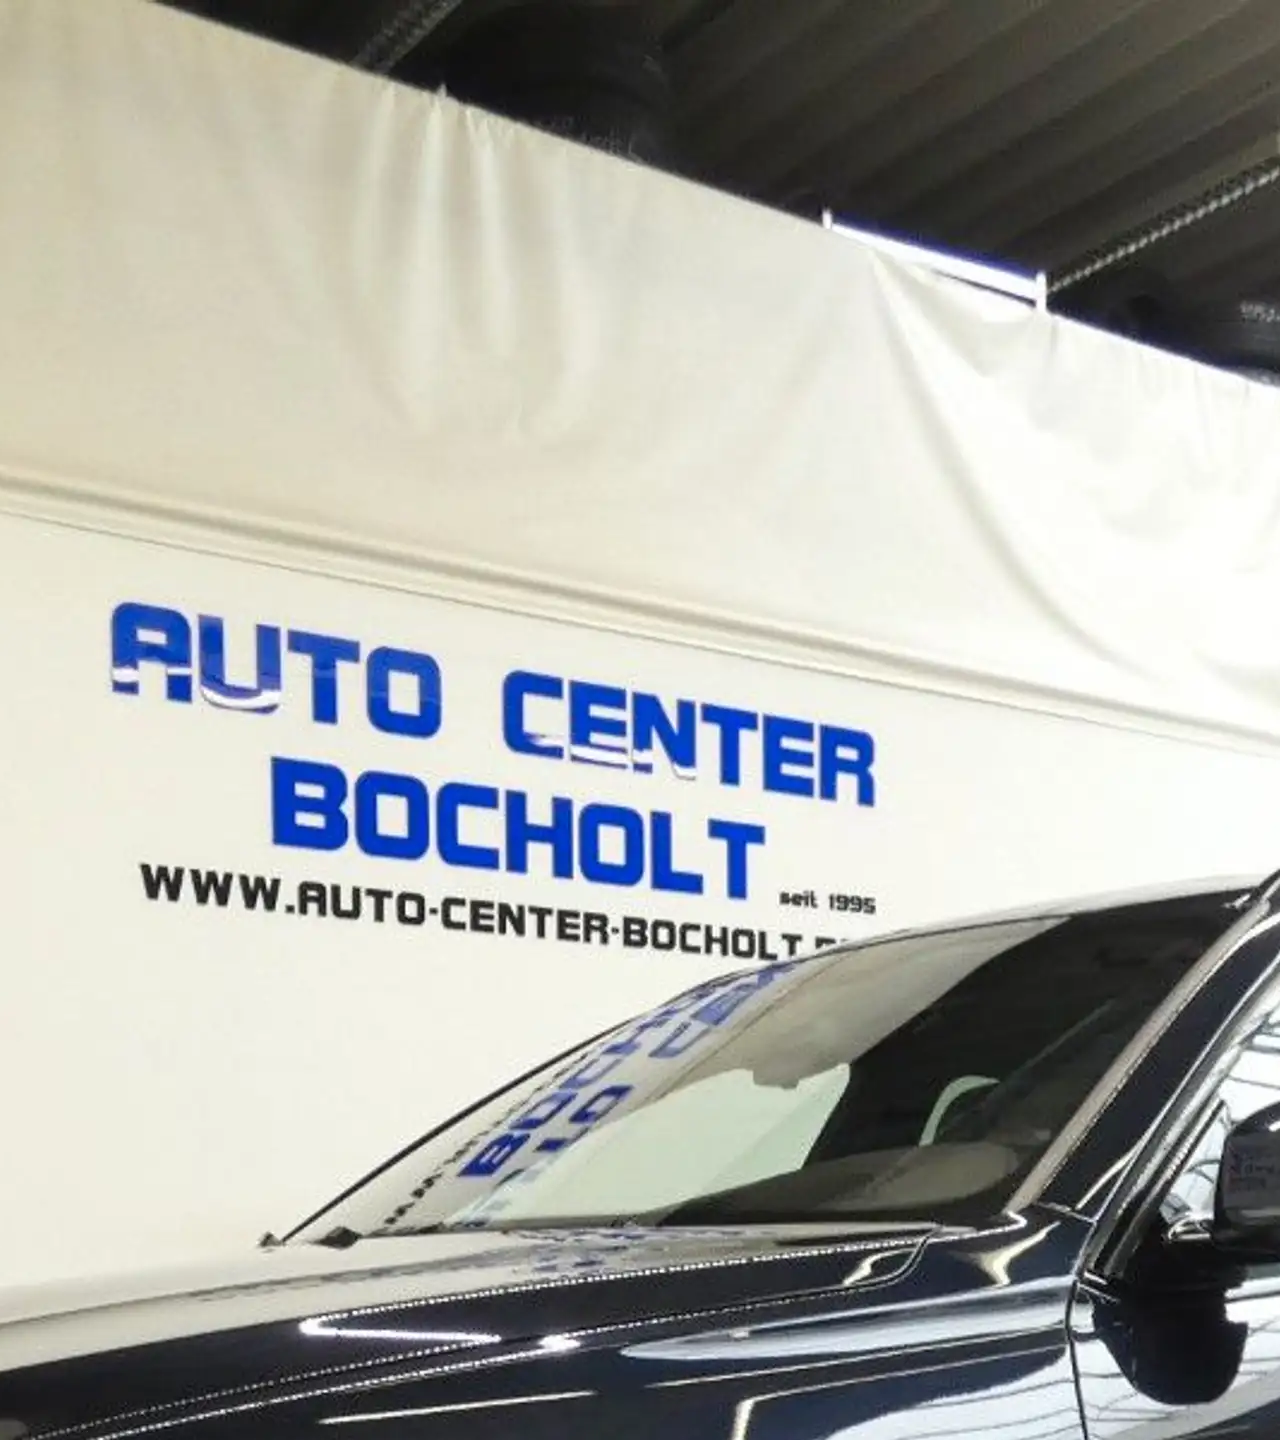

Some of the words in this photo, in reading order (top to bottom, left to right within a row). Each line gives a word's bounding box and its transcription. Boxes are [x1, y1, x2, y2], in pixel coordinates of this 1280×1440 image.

[111, 602, 444, 740] AUTO
[501, 669, 877, 807] CENTER
[270, 755, 767, 901] BOCHOLT
[140, 863, 848, 960] WWW.AUTO-CENTER-BOCHOLT
[780, 891, 818, 908] seit
[829, 893, 877, 914] 1995
